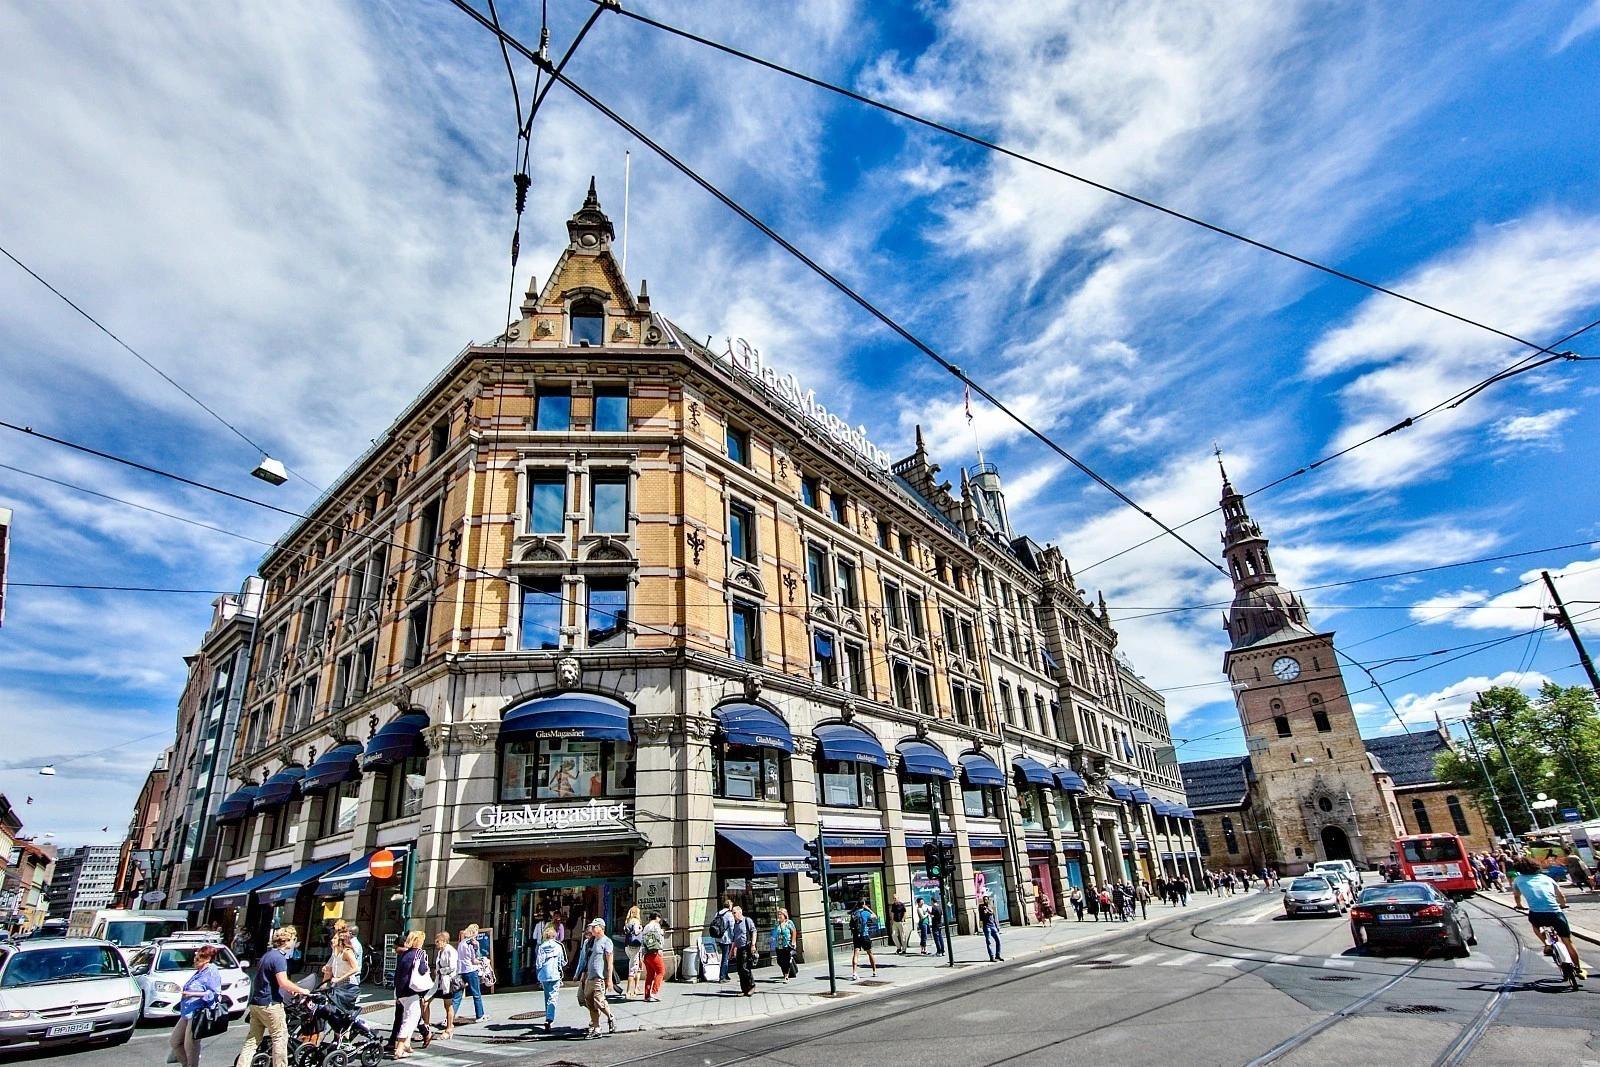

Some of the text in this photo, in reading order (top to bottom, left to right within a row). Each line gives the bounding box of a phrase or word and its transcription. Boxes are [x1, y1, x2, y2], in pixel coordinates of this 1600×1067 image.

[728, 336, 893, 475] GlasMagasinet
[535, 728, 585, 738] GlasMagasinet
[475, 799, 627, 828] GlasMagasinet
[540, 862, 601, 874] GlasMagasinet
